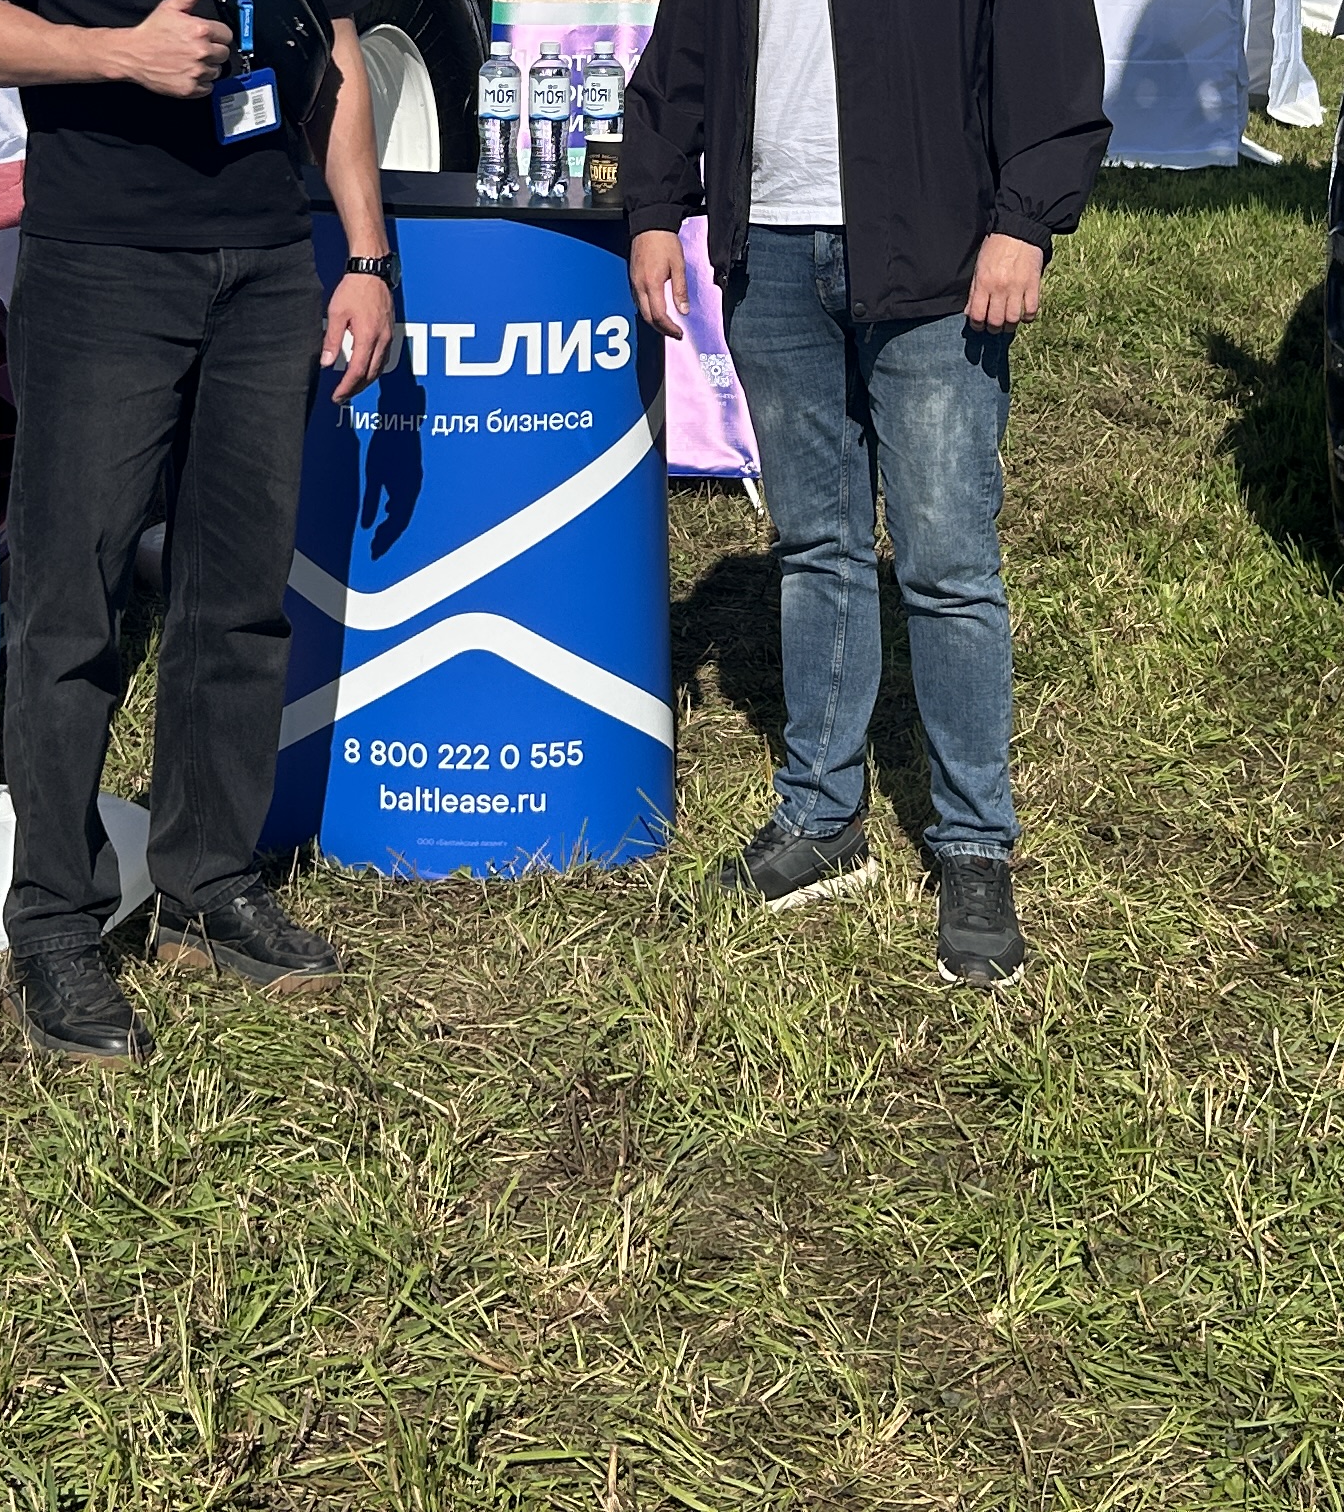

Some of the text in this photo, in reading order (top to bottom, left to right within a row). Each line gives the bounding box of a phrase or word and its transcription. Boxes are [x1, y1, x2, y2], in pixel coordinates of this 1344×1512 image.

[590, 165, 618, 180] COFFEE
[336, 405, 593, 436] Лизинг для бизнеса
[344, 738, 584, 770] 8 800 222 0 555
[379, 784, 547, 814] baltlease.ru
